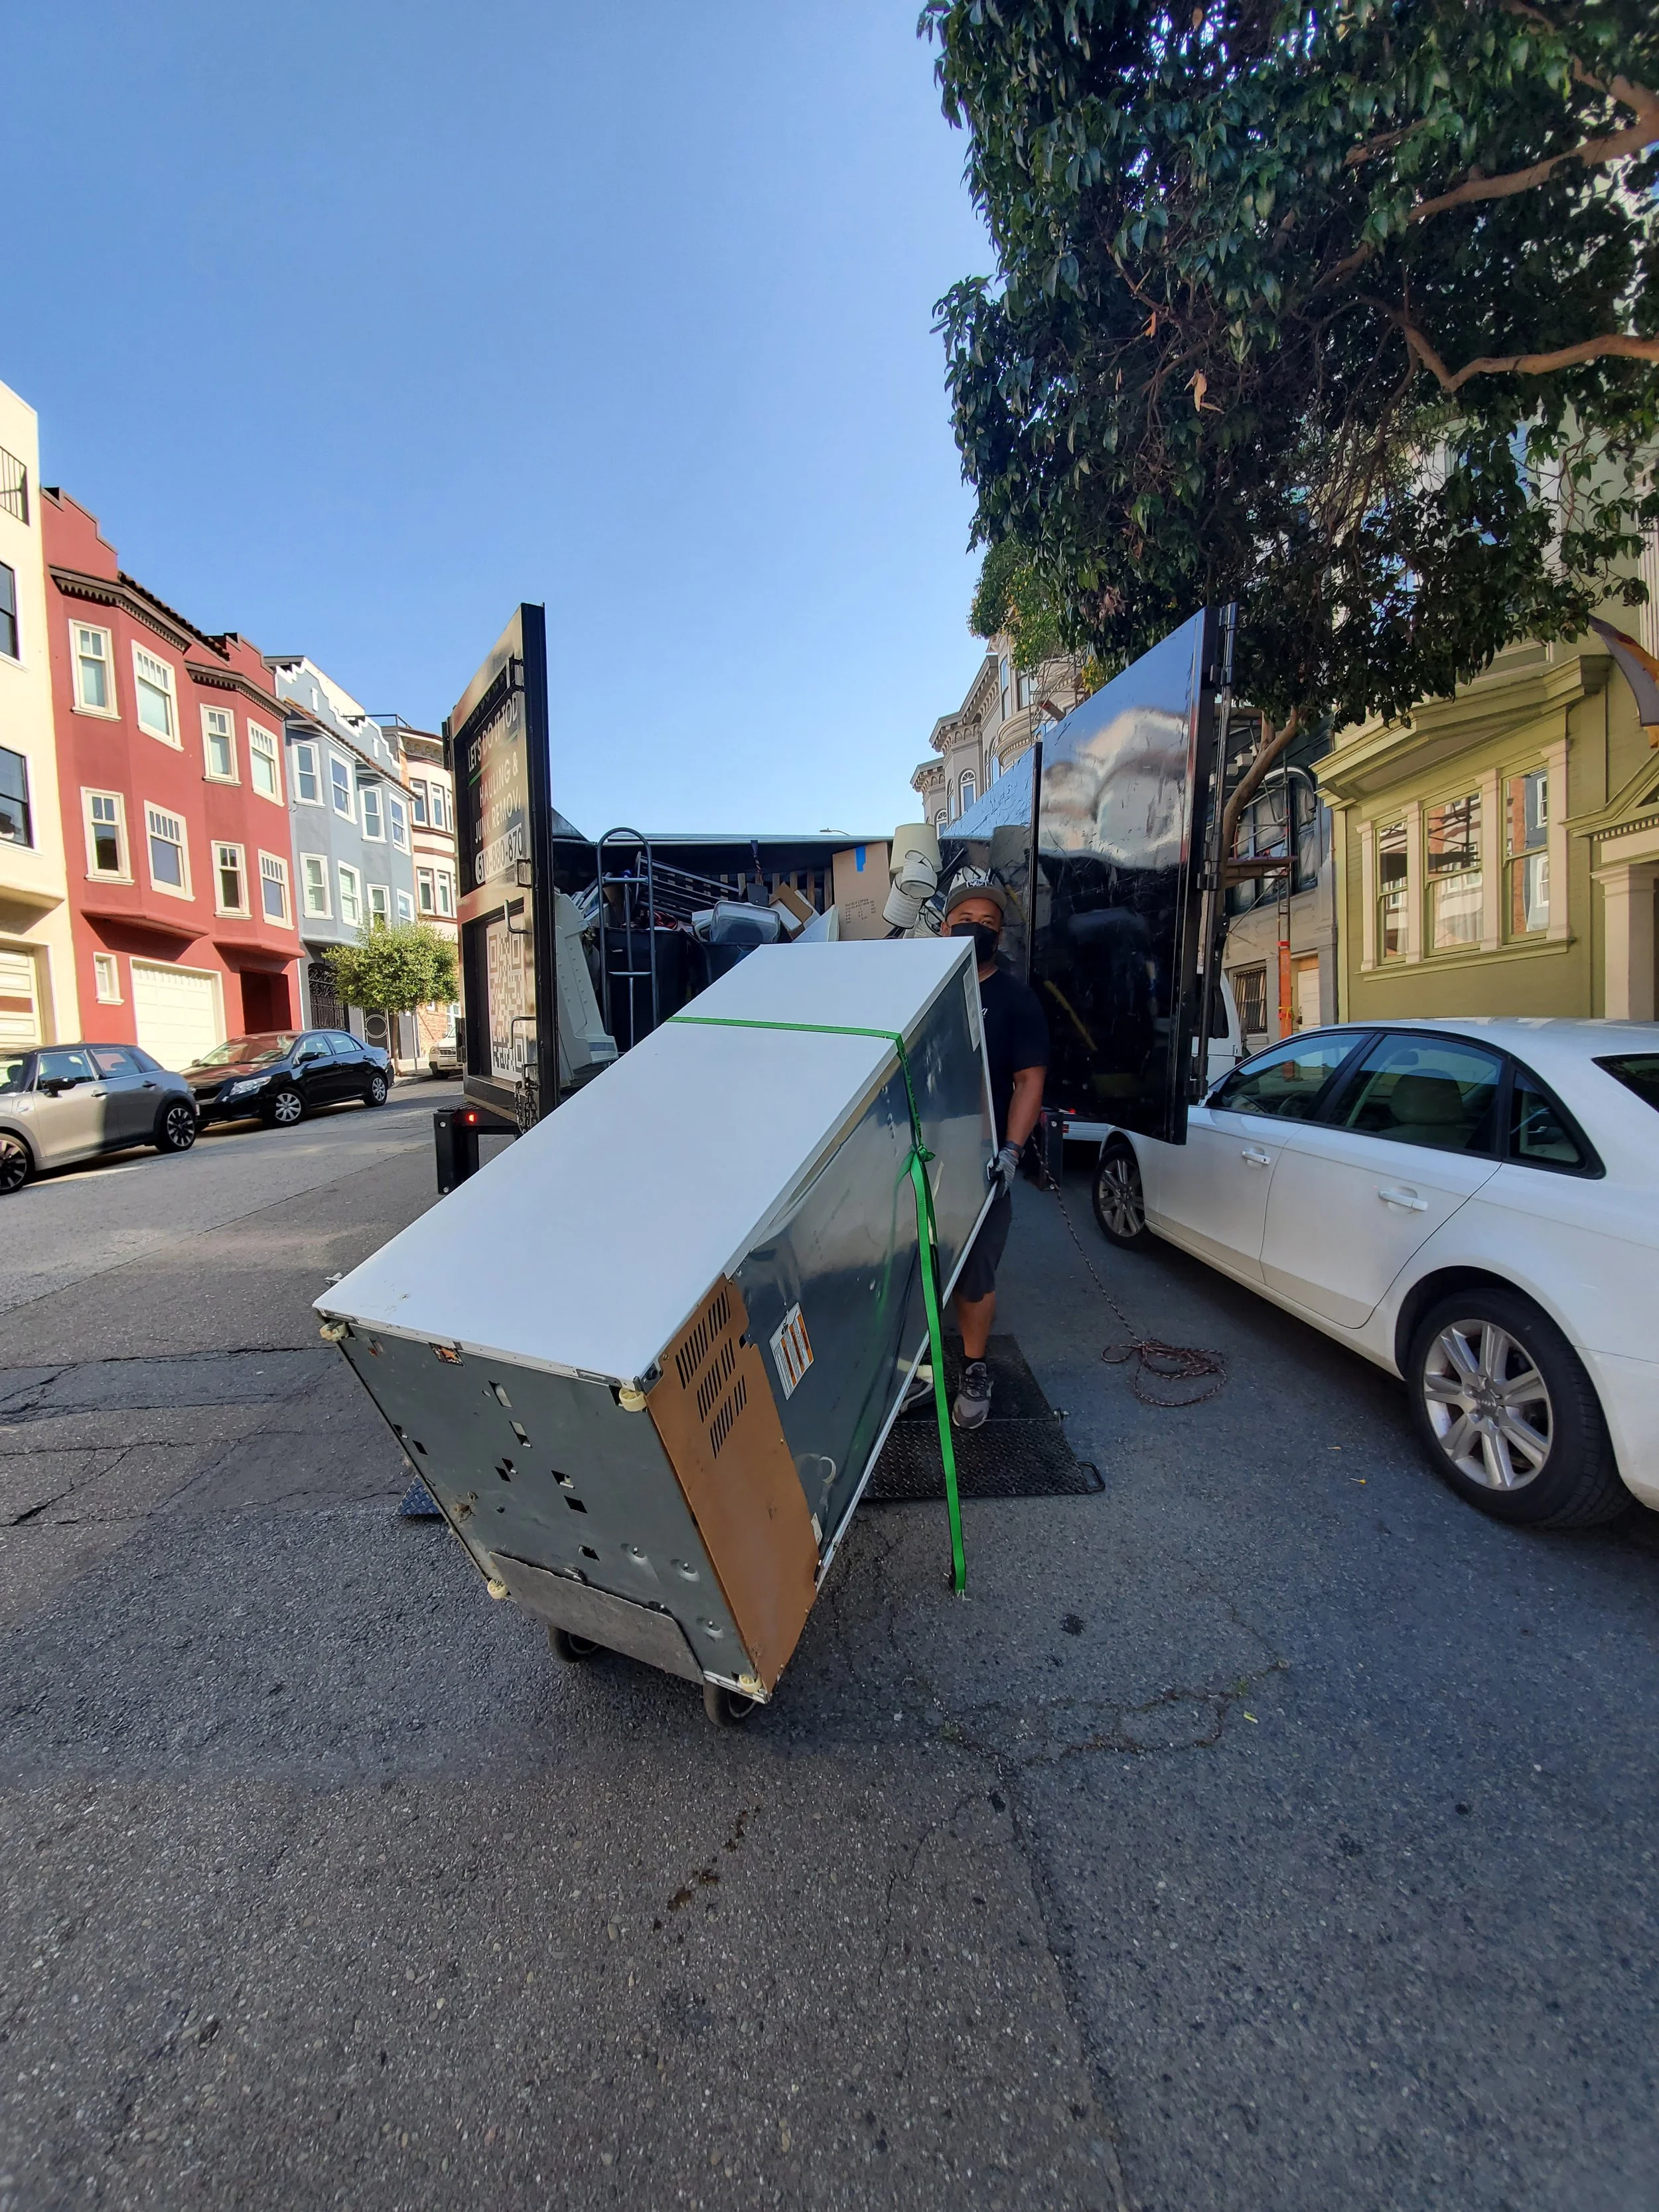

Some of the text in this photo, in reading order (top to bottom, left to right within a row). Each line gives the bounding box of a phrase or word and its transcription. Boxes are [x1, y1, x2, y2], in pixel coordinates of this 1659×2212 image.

[467, 736, 482, 773] LET'S
[482, 722, 493, 756] DO
[494, 710, 501, 742] IT
[479, 751, 518, 808] HAULING &
[475, 811, 490, 844] JUNK
